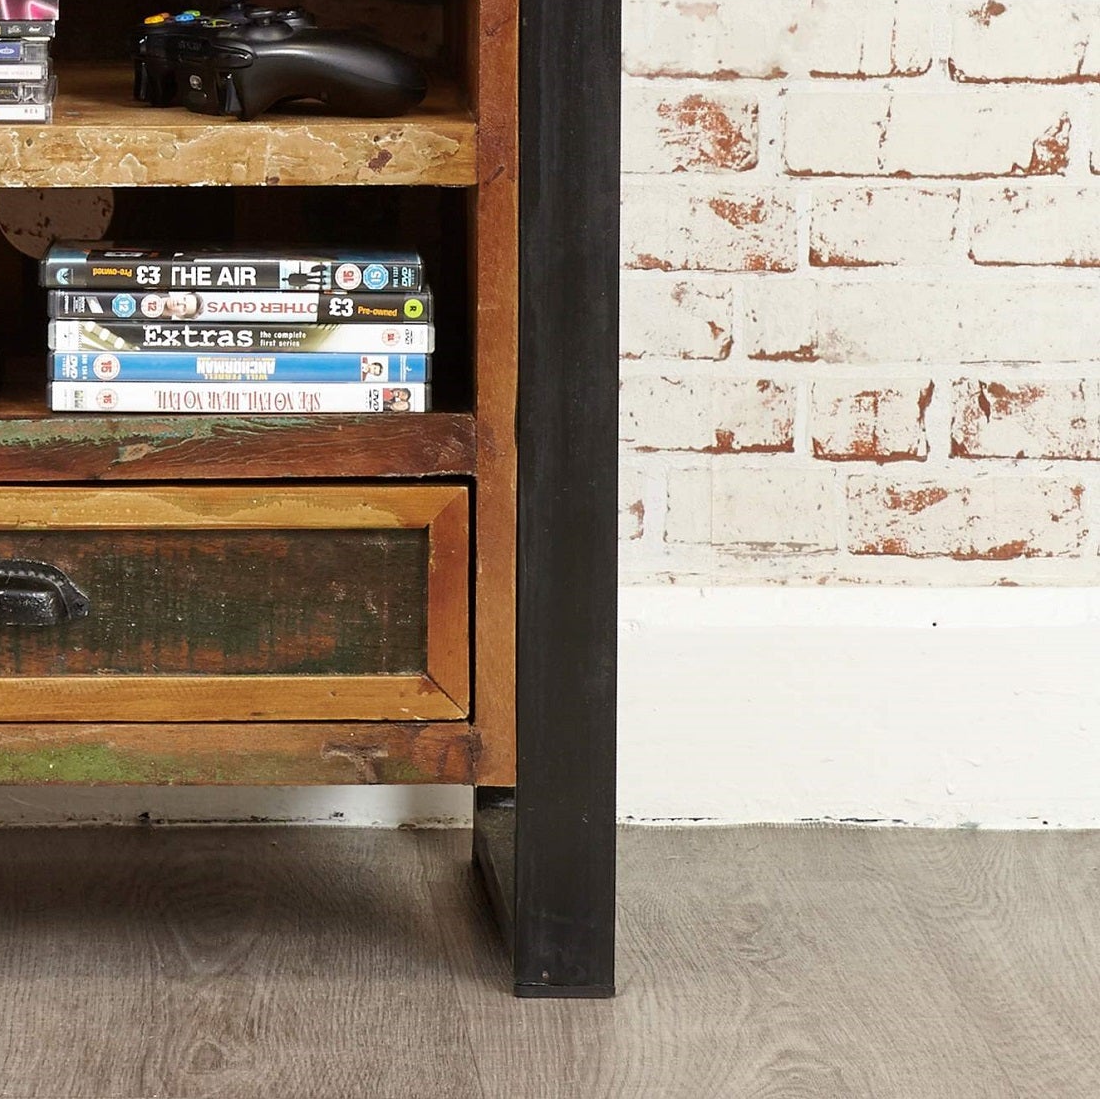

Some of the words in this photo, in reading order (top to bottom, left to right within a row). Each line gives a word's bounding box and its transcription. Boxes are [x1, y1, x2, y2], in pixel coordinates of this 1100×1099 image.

[92, 267, 133, 278] Pre-owned
[136, 265, 161, 285] £3
[217, 266, 257, 286] AIR
[343, 270, 354, 282] 15
[370, 270, 381, 283] 15
[119, 300, 130, 312] 12
[148, 301, 157, 312] 12
[207, 302, 257, 314] GUYS
[260, 302, 318, 314] OTHER
[329, 297, 354, 317] £3
[357, 306, 398, 318] Pre-owned
[143, 324, 254, 347] Extras
[260, 330, 272, 339] the
[274, 331, 306, 340] complete
[69, 356, 78, 379] DVD
[101, 361, 112, 373] 15
[196, 360, 276, 374] ANCHORMAN
[154, 390, 180, 410] EVIL
[184, 390, 204, 410] NO
[208, 391, 239, 411] HEAR
[274, 392, 294, 412] NO
[298, 392, 320, 412] SEE
